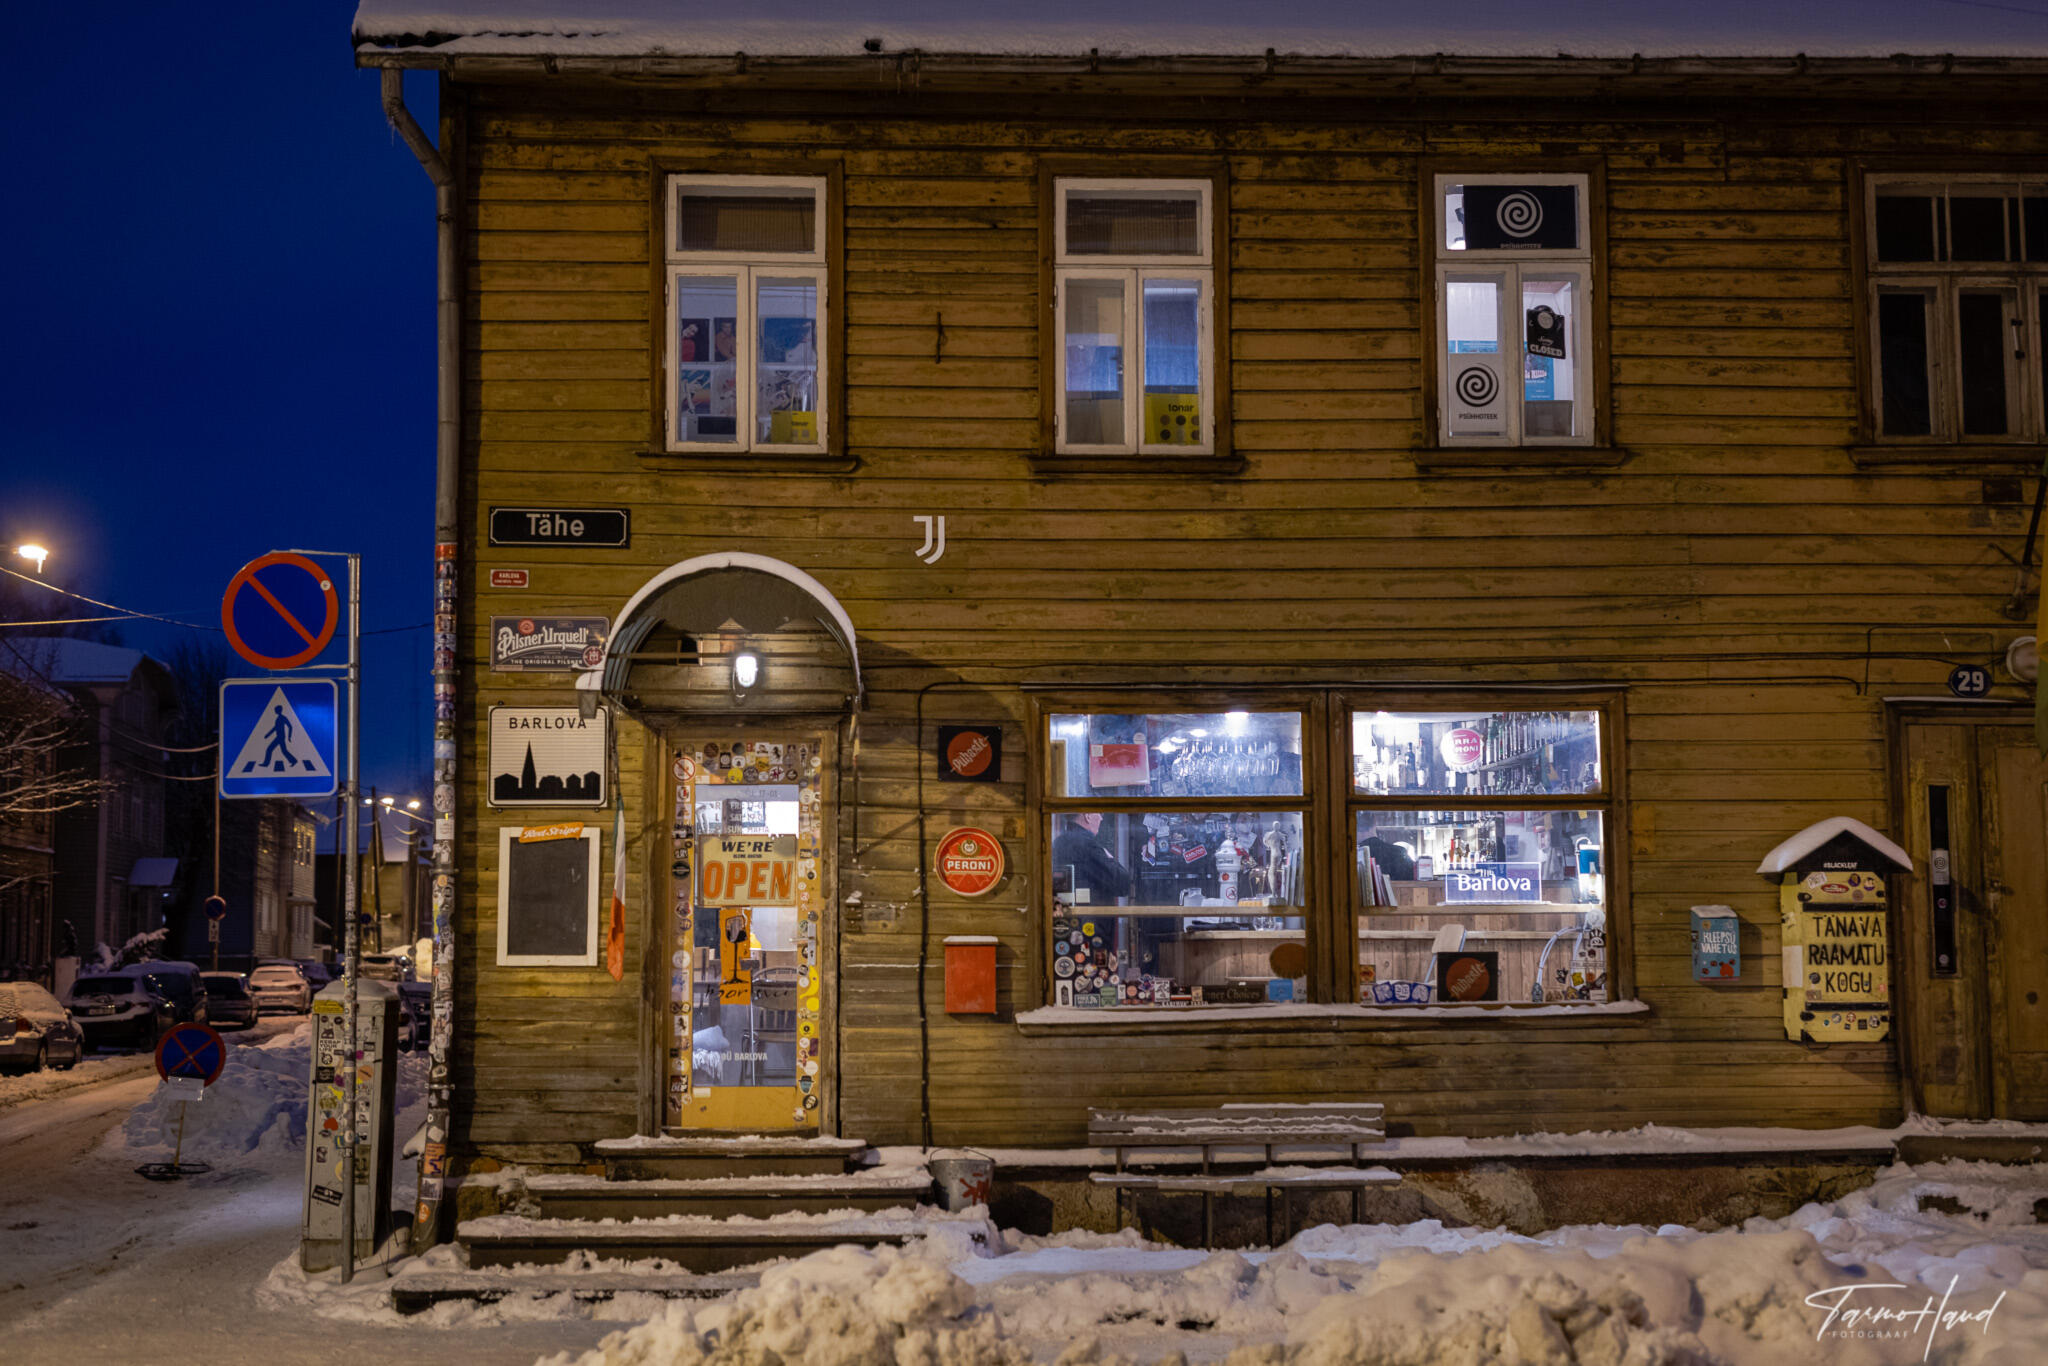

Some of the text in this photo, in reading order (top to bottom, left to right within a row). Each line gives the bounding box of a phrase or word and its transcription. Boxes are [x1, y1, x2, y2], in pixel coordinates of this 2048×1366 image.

[1530, 344, 1563, 357] CLOSED
[526, 513, 585, 537] Tähe
[497, 625, 587, 659] Pilsner Urquell
[1957, 671, 1985, 692] 29
[508, 716, 587, 729] BARLOVA
[721, 841, 774, 853] WE'RE
[947, 860, 991, 870] PERONI
[703, 860, 794, 899] OPEN
[1457, 872, 1532, 892] Barlova
[1813, 914, 1883, 937] TÄNAVA
[1701, 943, 1737, 954] VAHETUS
[1809, 943, 1885, 966] RAAMATU
[1825, 972, 1873, 993] KOGU
[1226, 988, 1261, 1000] Choices
[734, 1052, 768, 1061] BARLOVA
